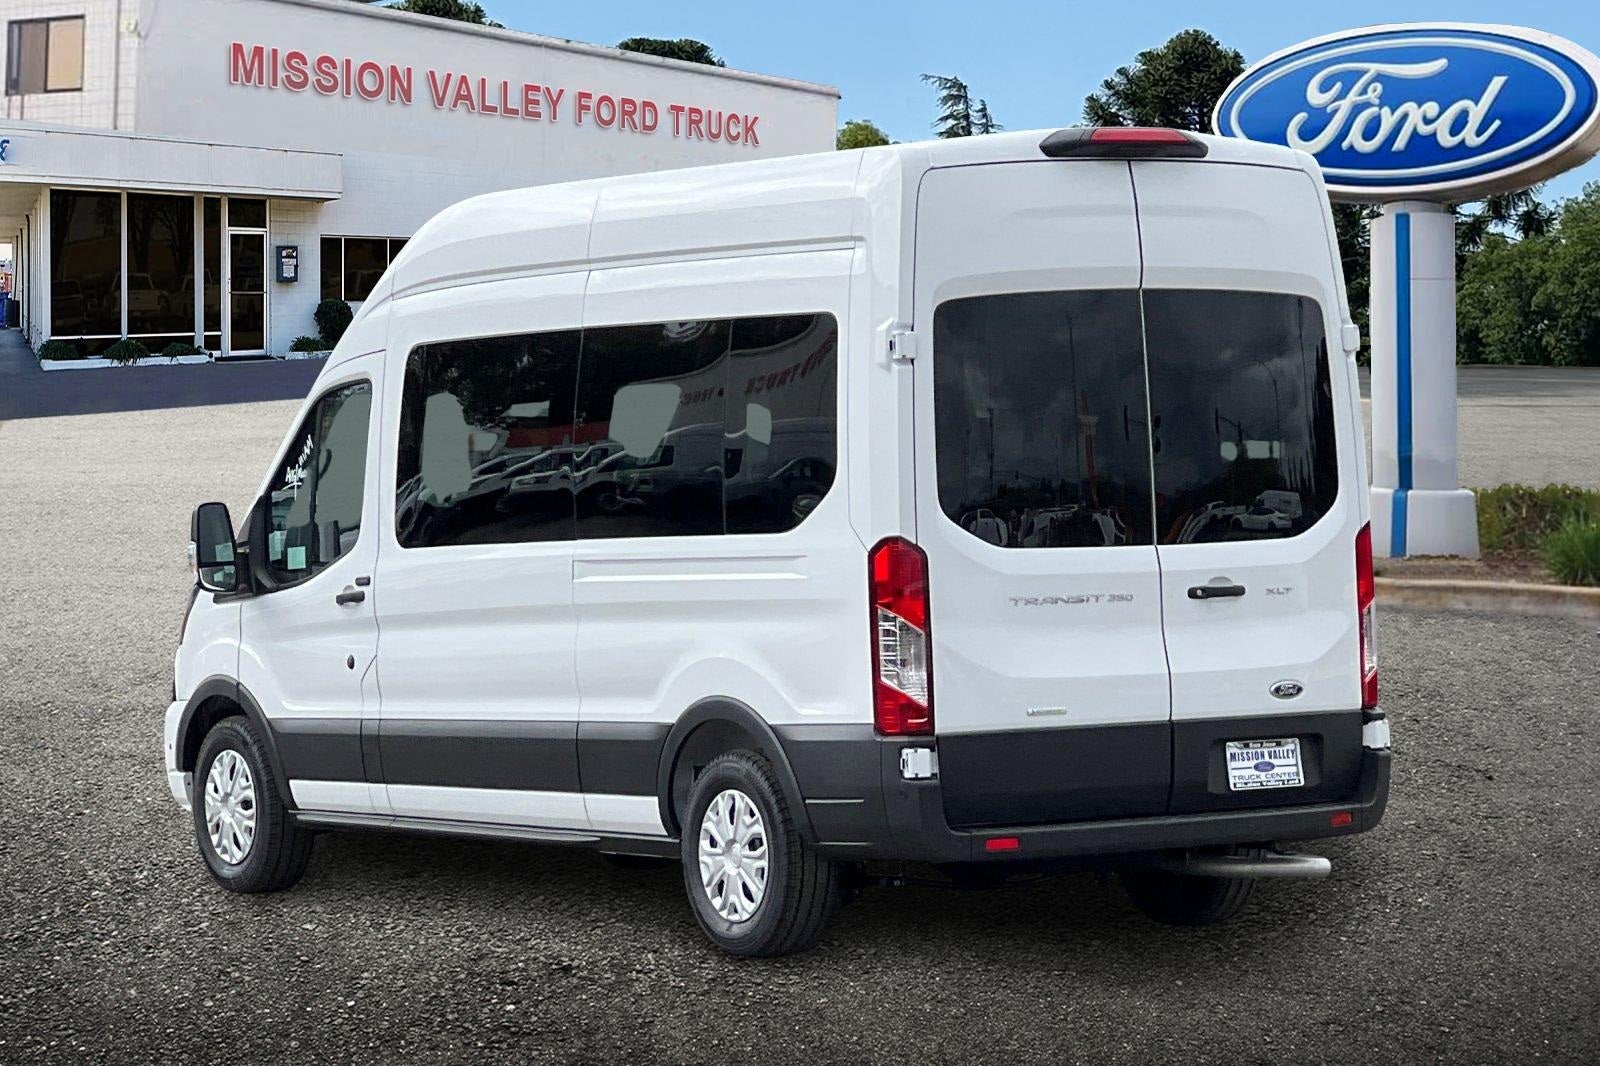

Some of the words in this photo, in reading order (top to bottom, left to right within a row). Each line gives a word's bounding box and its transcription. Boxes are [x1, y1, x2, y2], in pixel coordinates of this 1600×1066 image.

[229, 41, 413, 105] MISSION
[427, 69, 565, 122] VALLEY
[575, 90, 659, 134] FORD
[669, 103, 760, 146] TRUCK
[1286, 57, 1509, 154] Ford
[1265, 587, 1293, 596] XLT
[1009, 594, 1105, 607] TRANSIT
[1230, 750, 1265, 762] MISSION
[1268, 749, 1296, 759] VALLEY
